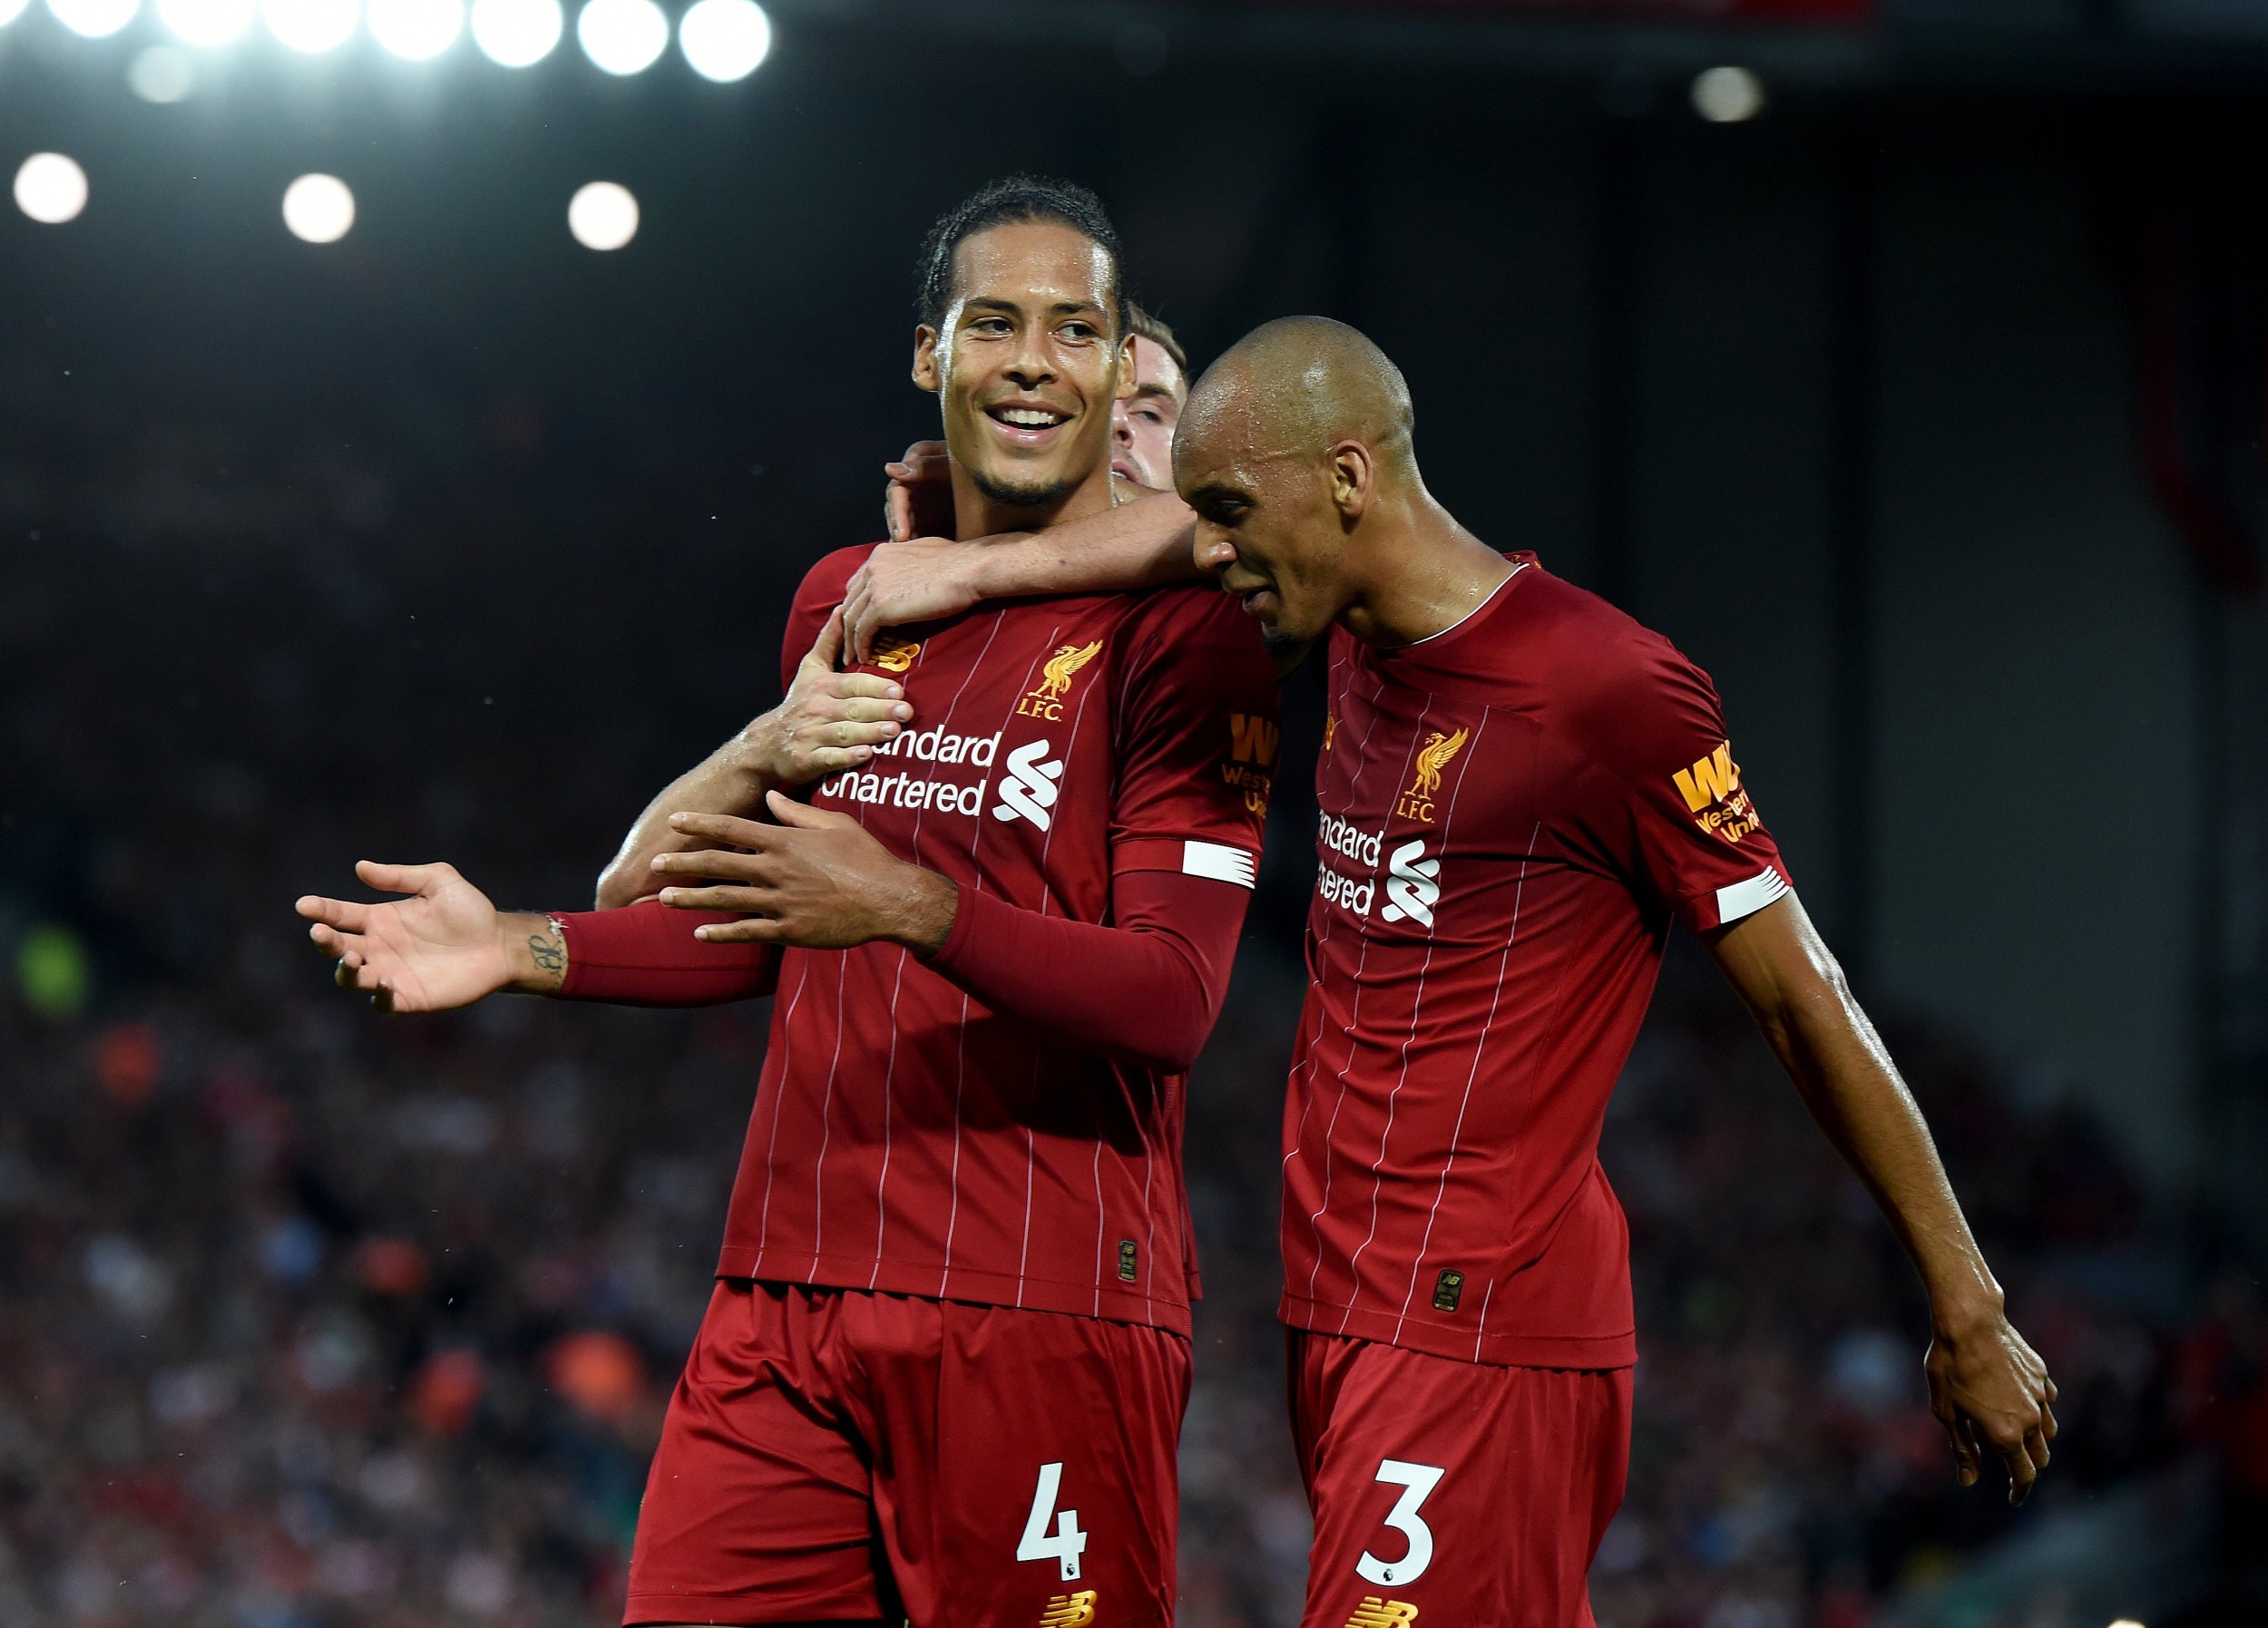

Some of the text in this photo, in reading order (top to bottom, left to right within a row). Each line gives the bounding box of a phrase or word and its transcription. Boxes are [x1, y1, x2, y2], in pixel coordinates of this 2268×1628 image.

[870, 724, 1003, 768] ndard
[1319, 808, 1384, 868] ndard
[1317, 858, 1375, 916] tered
[1016, 1462, 1088, 1582] 4
[1354, 1458, 1447, 1587] 3
